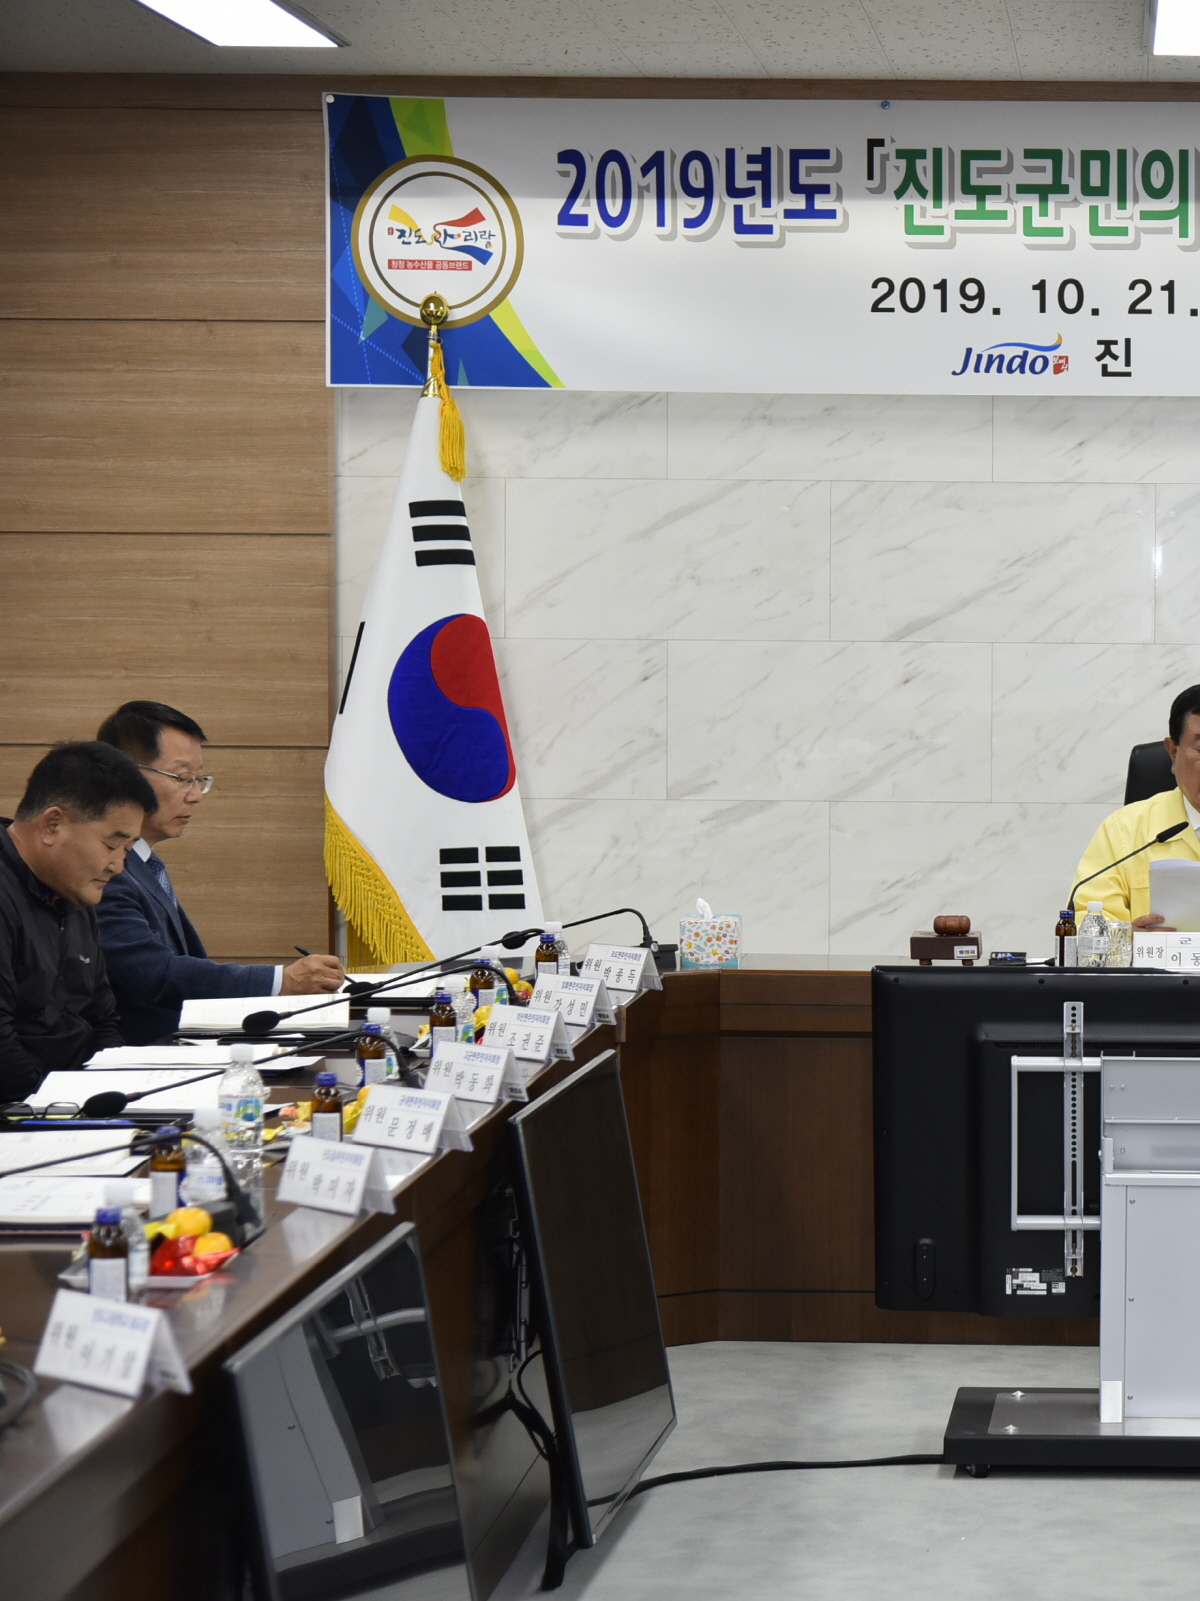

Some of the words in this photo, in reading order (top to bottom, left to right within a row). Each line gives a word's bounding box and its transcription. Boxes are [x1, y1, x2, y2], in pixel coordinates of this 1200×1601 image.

[557, 147, 837, 235] 2019년도
[870, 277, 1001, 315] 2019.
[1032, 278, 1100, 316] 10.
[951, 347, 1050, 376] Jindo
[1136, 946, 1165, 960] 위원장
[584, 957, 602, 972] 위원
[534, 989, 552, 1004] 위원
[488, 1021, 507, 1038] 위원
[432, 1060, 453, 1078] 위원
[363, 1104, 387, 1124] 위원
[286, 1159, 310, 1182] 위원
